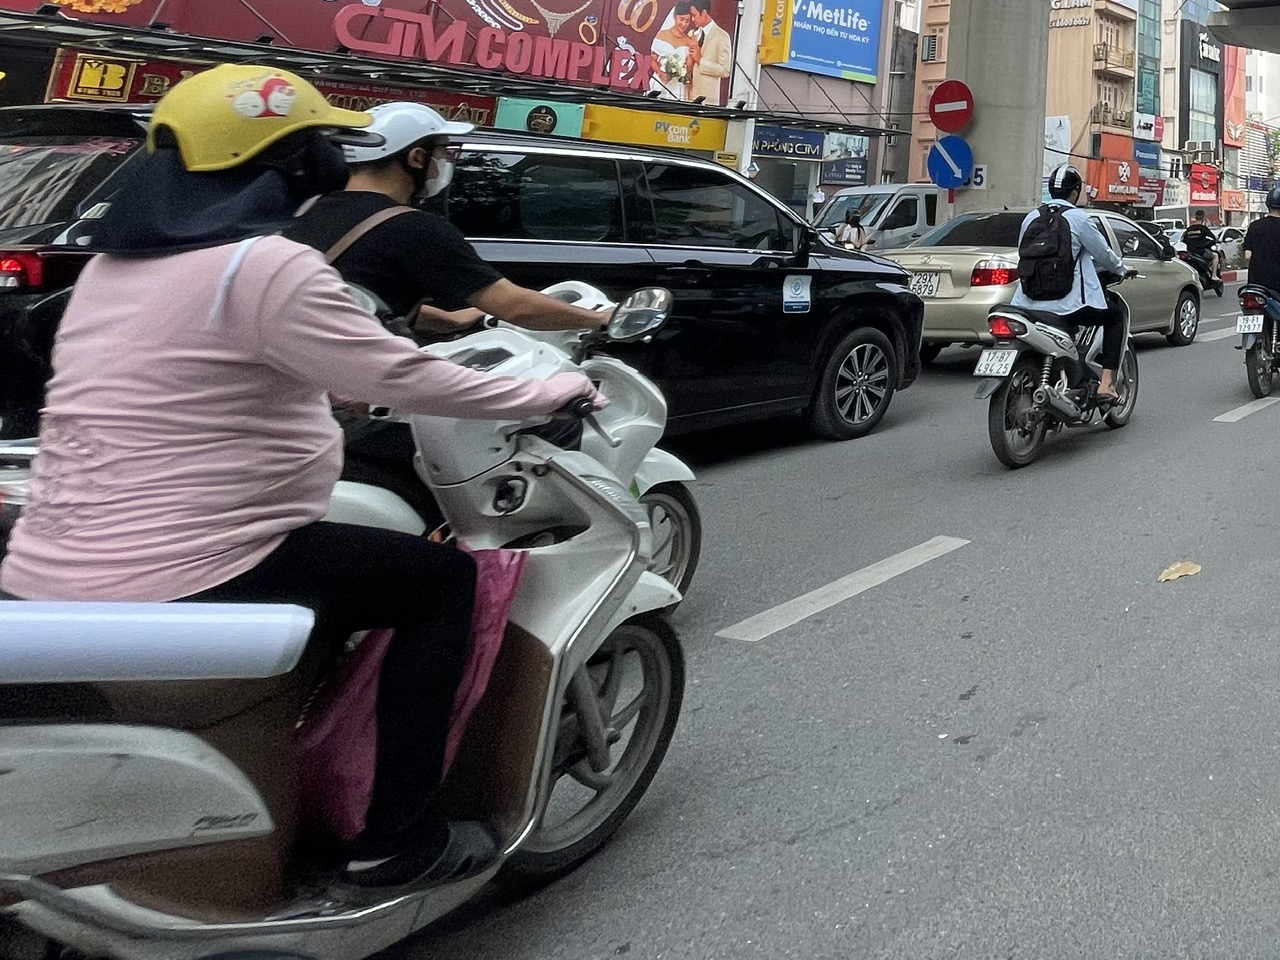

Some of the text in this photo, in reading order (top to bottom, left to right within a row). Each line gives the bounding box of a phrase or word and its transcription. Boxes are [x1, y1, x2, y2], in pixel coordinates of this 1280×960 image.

[807, 0, 868, 32] MetLife
[475, 26, 652, 90] COMPLEX
[916, 273, 934, 284] 29X
